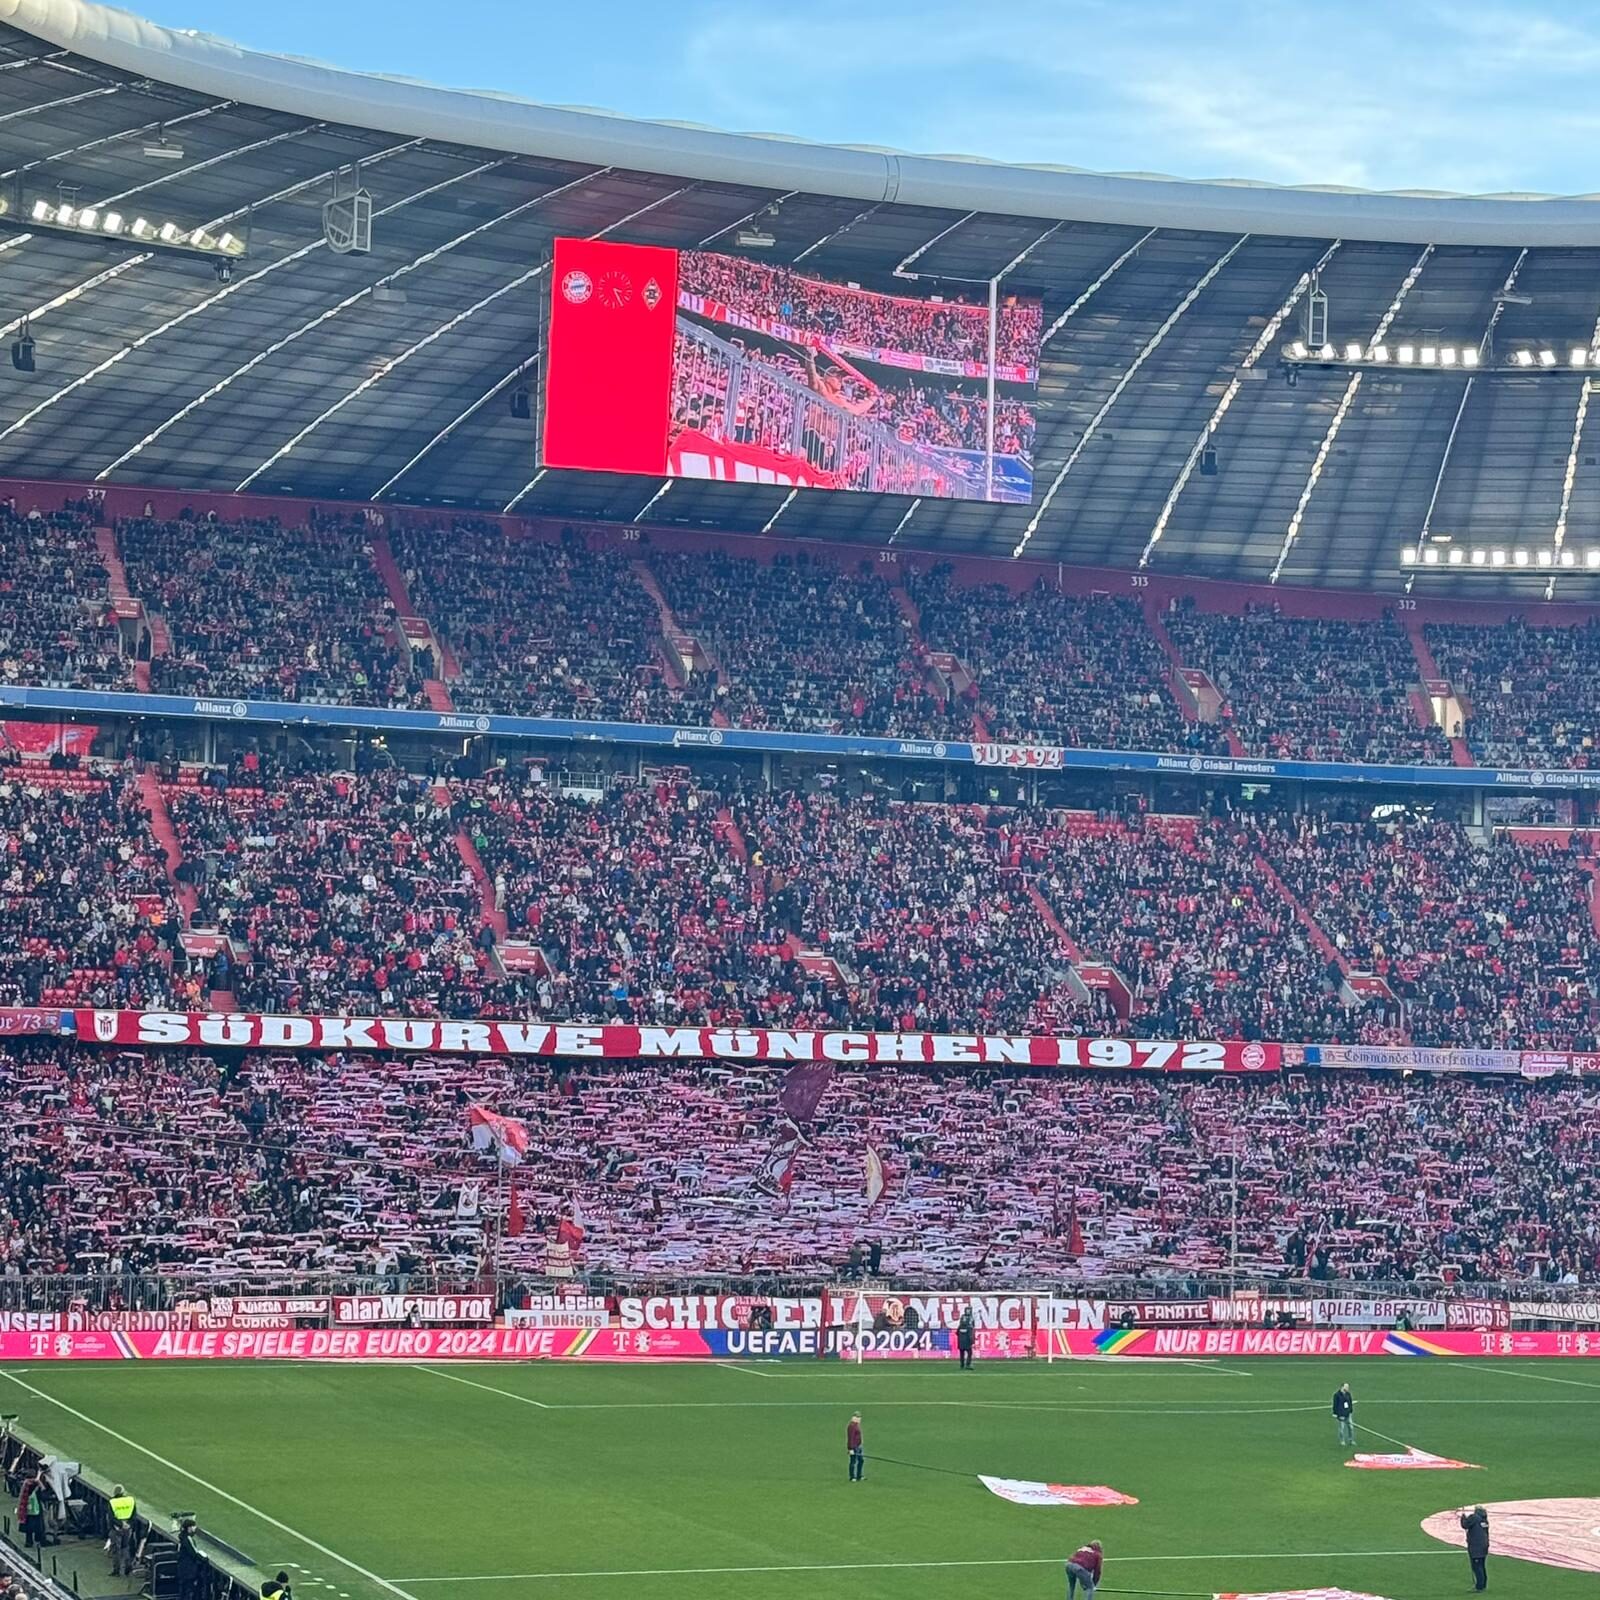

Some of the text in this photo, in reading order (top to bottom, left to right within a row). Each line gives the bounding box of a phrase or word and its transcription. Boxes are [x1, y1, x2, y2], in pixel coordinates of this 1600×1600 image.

[622, 529, 640, 541] 315
[879, 551, 897, 563] 314
[1131, 576, 1149, 587] 313
[1398, 600, 1416, 610] 312
[193, 701, 232, 713] Allianz
[439, 716, 475, 729] Allianz
[673, 730, 708, 743] Allianz
[899, 743, 933, 755] Allianz
[1156, 758, 1276, 773] Allianz Global Investors
[1495, 773, 1530, 783] Allianz
[1545, 774, 1578, 784] Global
[137, 1013, 604, 1056] SÜDKURVE
[638, 1027, 1032, 1064] MÜNCHEN
[1056, 1038, 1227, 1070] 1972
[459, 1299, 493, 1320] rot
[619, 1295, 875, 1329] SCHICERIA
[1318, 1301, 1362, 1316] ADLER
[154, 1332, 218, 1356] ALLE
[222, 1332, 308, 1356] SPIELE
[311, 1331, 360, 1355] DER
[365, 1331, 433, 1354] EURO
[437, 1331, 497, 1354] 2024
[502, 1331, 555, 1354] LIVE
[1154, 1330, 1375, 1353] NUR BEI MAGENTA TV
